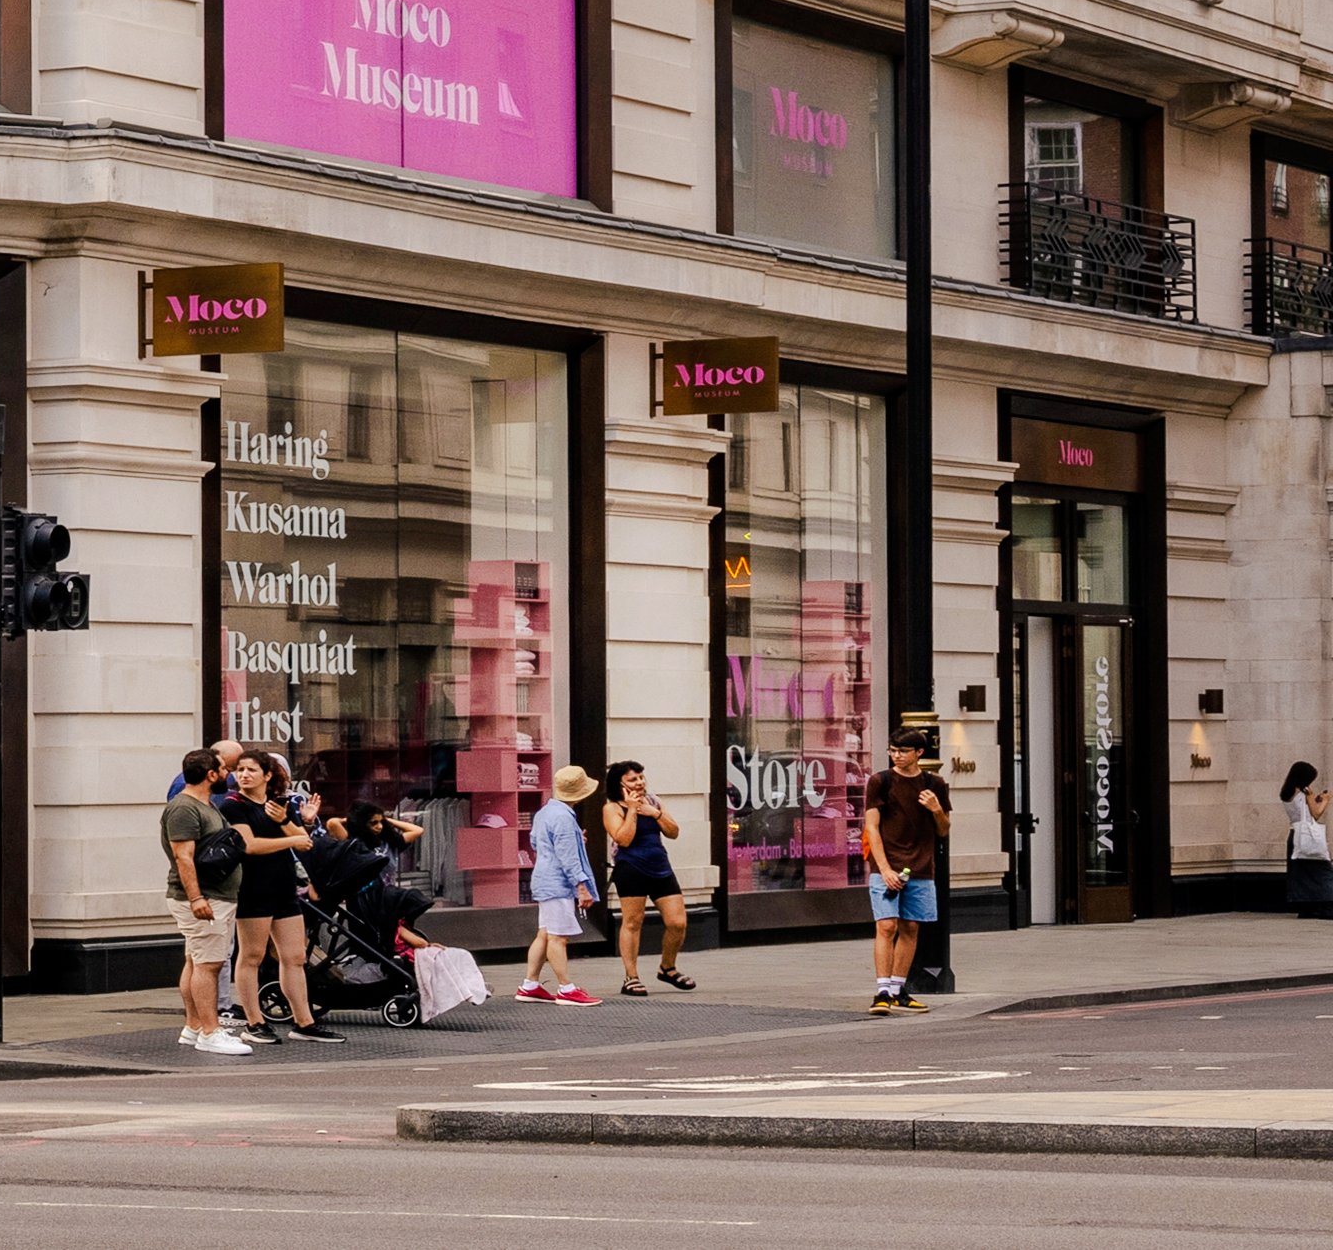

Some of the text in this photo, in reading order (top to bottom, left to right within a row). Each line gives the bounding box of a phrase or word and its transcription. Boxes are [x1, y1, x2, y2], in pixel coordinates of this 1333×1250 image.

[320, 41, 480, 126] Museum
[770, 86, 848, 150] Moco
[164, 294, 267, 323] Moco
[188, 326, 240, 335] MUSEUM
[673, 363, 765, 387] Moco
[694, 390, 741, 398] MUSEUM
[225, 420, 330, 480] Haring
[1058, 439, 1093, 467] Moco
[225, 490, 347, 539] Kusama
[225, 560, 338, 606] Warhol
[227, 629, 357, 685] Basquiat
[226, 696, 304, 743] Hirst
[726, 744, 827, 810] Store
